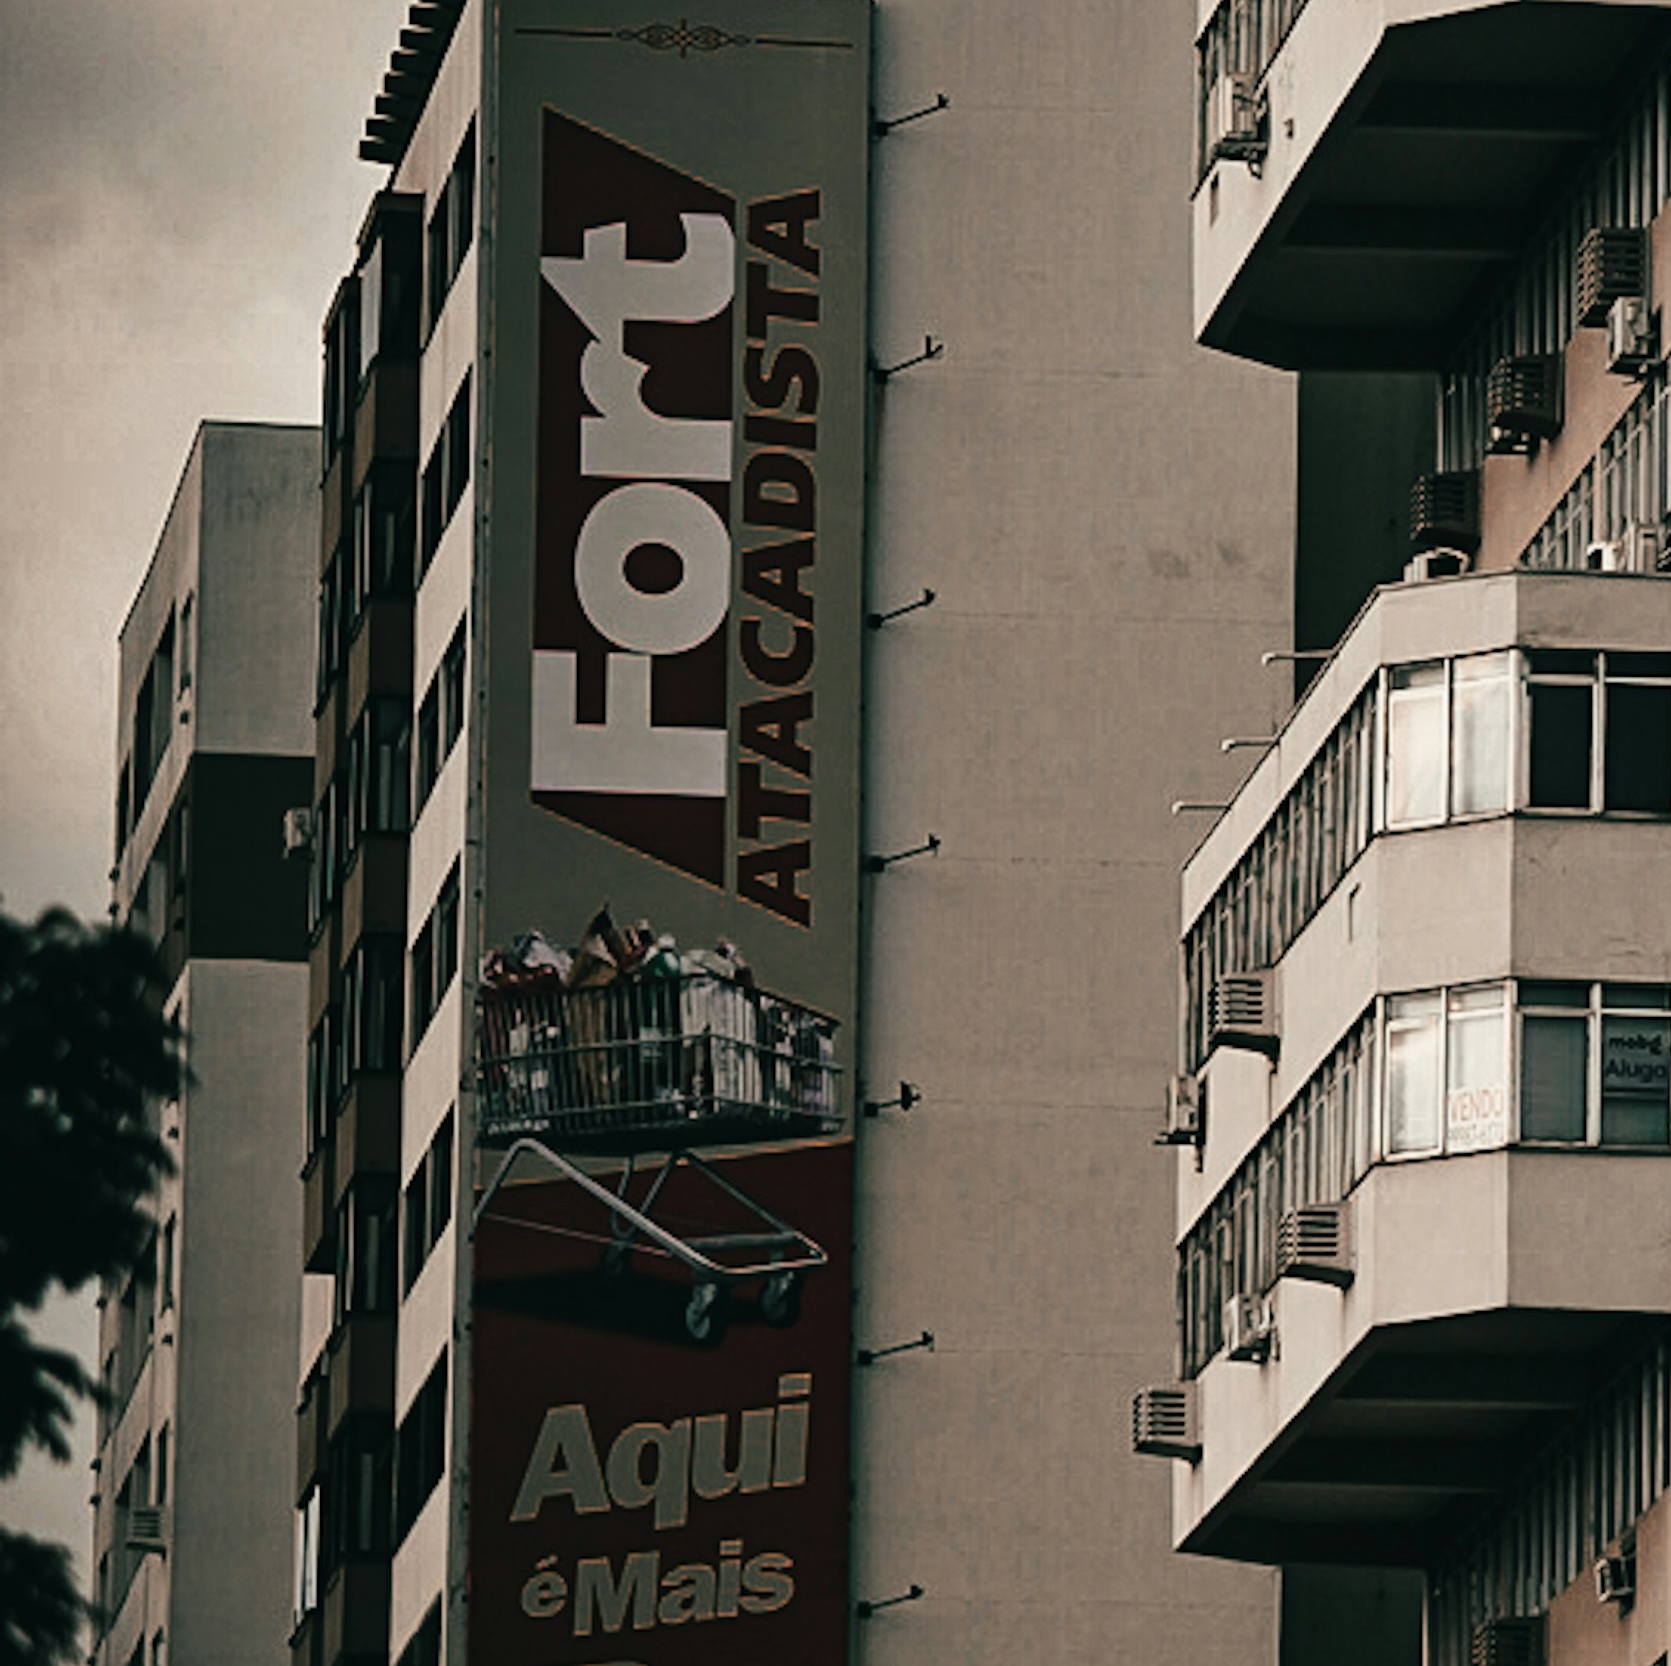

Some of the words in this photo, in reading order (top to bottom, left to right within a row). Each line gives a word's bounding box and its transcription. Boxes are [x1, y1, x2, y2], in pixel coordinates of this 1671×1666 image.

[530, 212, 736, 797] Fort
[736, 187, 821, 930] ATACADISTA
[510, 1373, 813, 1529] Aqui
[573, 1540, 796, 1636] Mais
